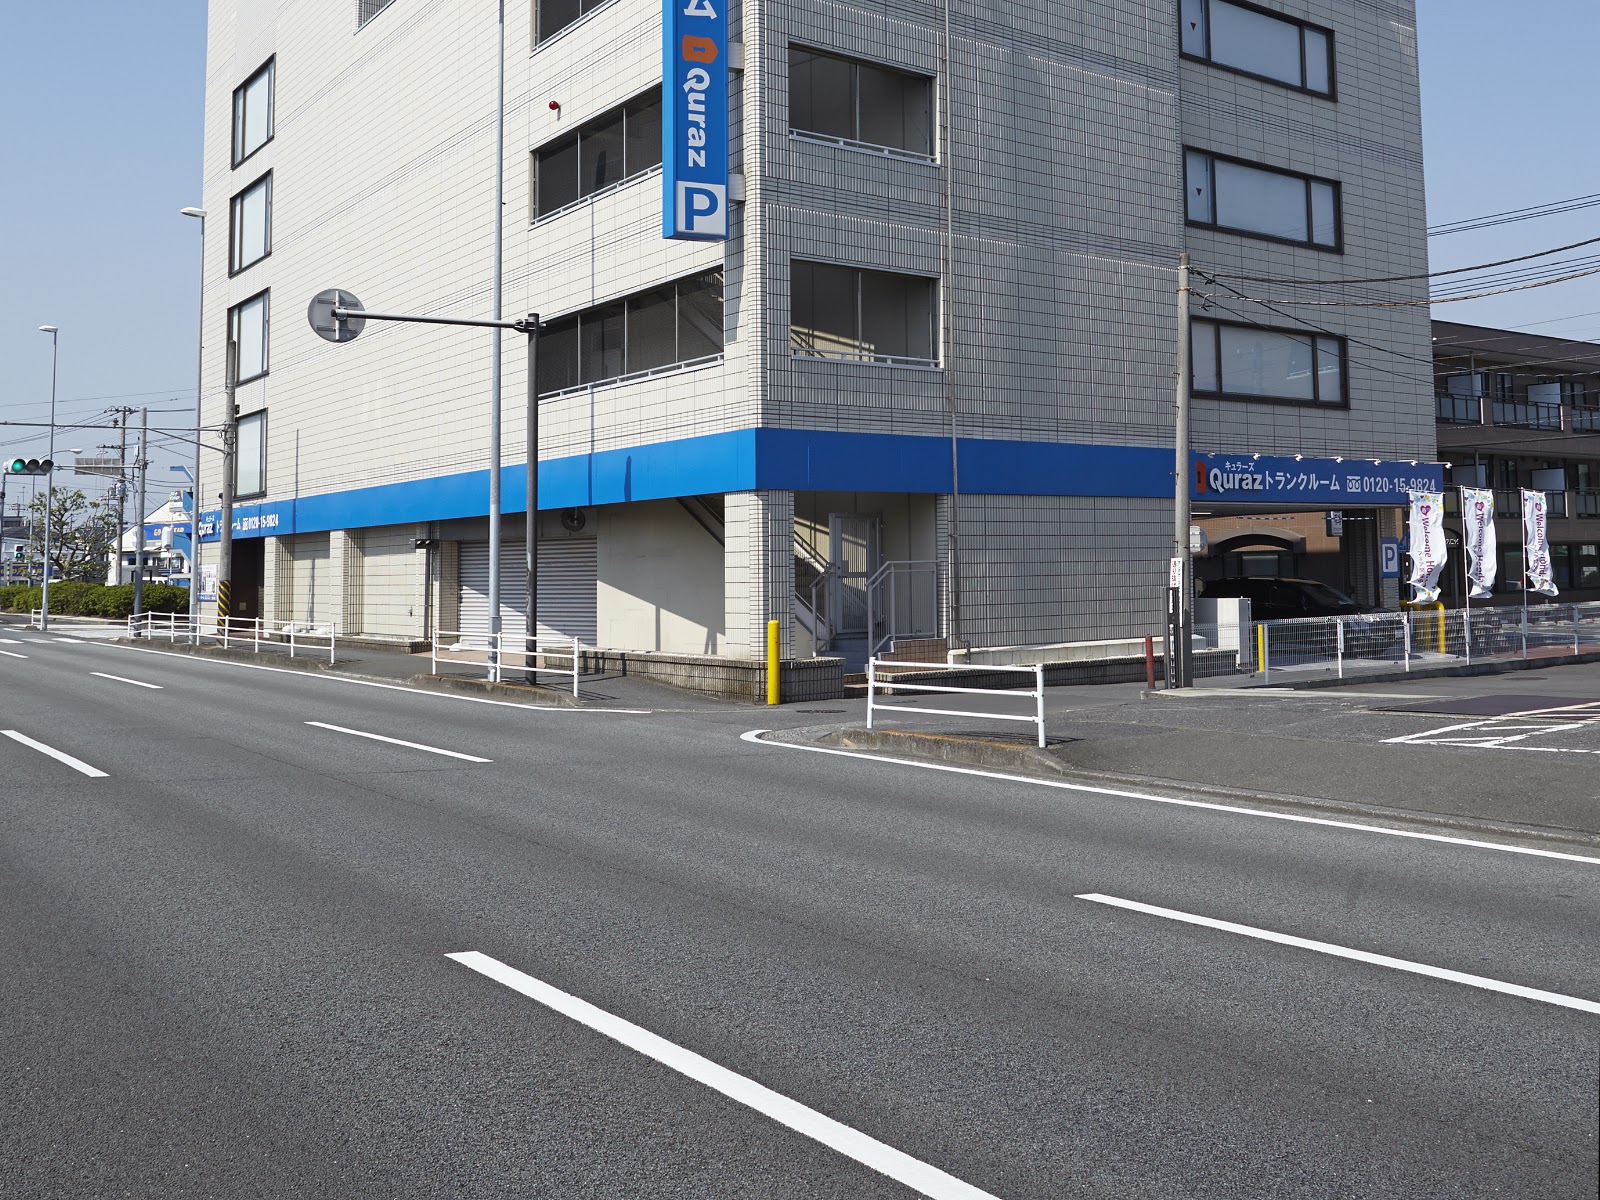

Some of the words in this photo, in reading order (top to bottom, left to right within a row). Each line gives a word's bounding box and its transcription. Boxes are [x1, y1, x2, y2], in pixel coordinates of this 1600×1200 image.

[683, 67, 710, 168] Quraz
[685, 186, 719, 231] P
[1209, 468, 1263, 493] Quraz
[1265, 471, 1341, 491] トランクルーム
[1225, 461, 1254, 472] キュラーズ
[1422, 517, 1431, 557] Welcome
[1476, 514, 1484, 552] Welcome
[1536, 514, 1545, 551] Welcom
[1385, 546, 1395, 569] P
